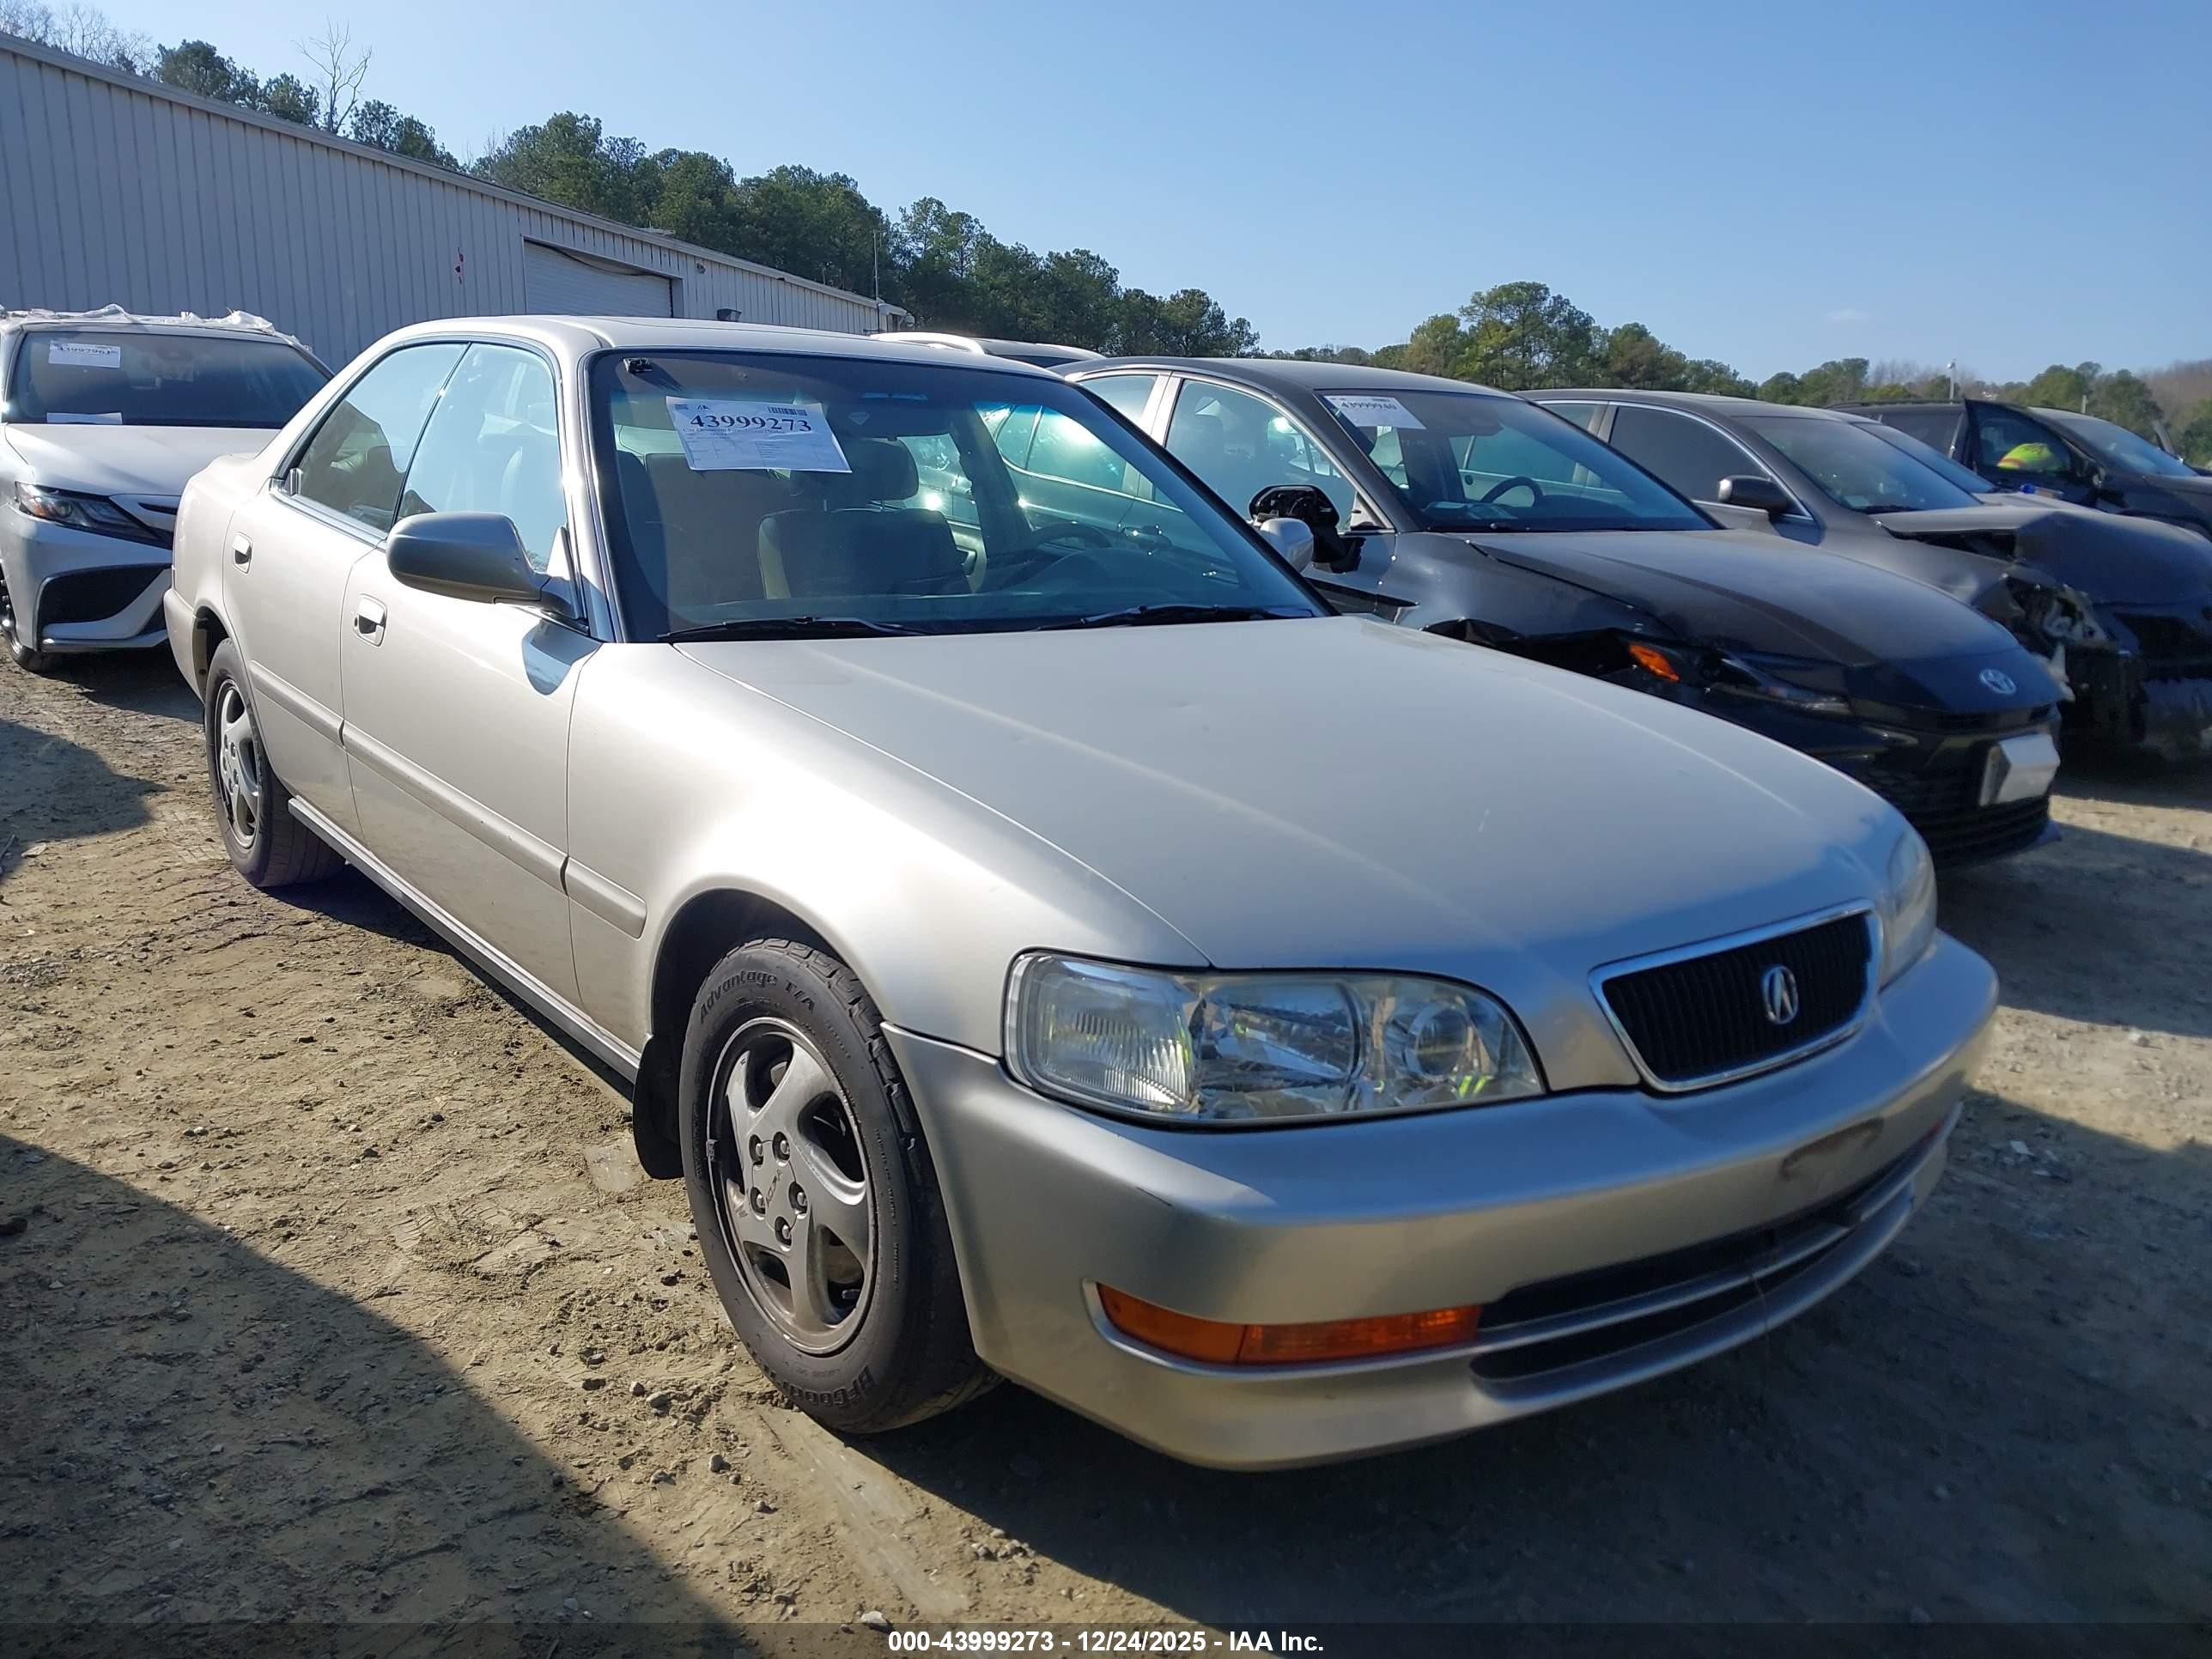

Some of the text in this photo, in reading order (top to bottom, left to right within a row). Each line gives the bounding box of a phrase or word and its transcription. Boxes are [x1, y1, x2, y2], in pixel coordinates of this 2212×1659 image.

[690, 414, 812, 433] 43999273
[700, 969, 817, 1025] Advantage T/A
